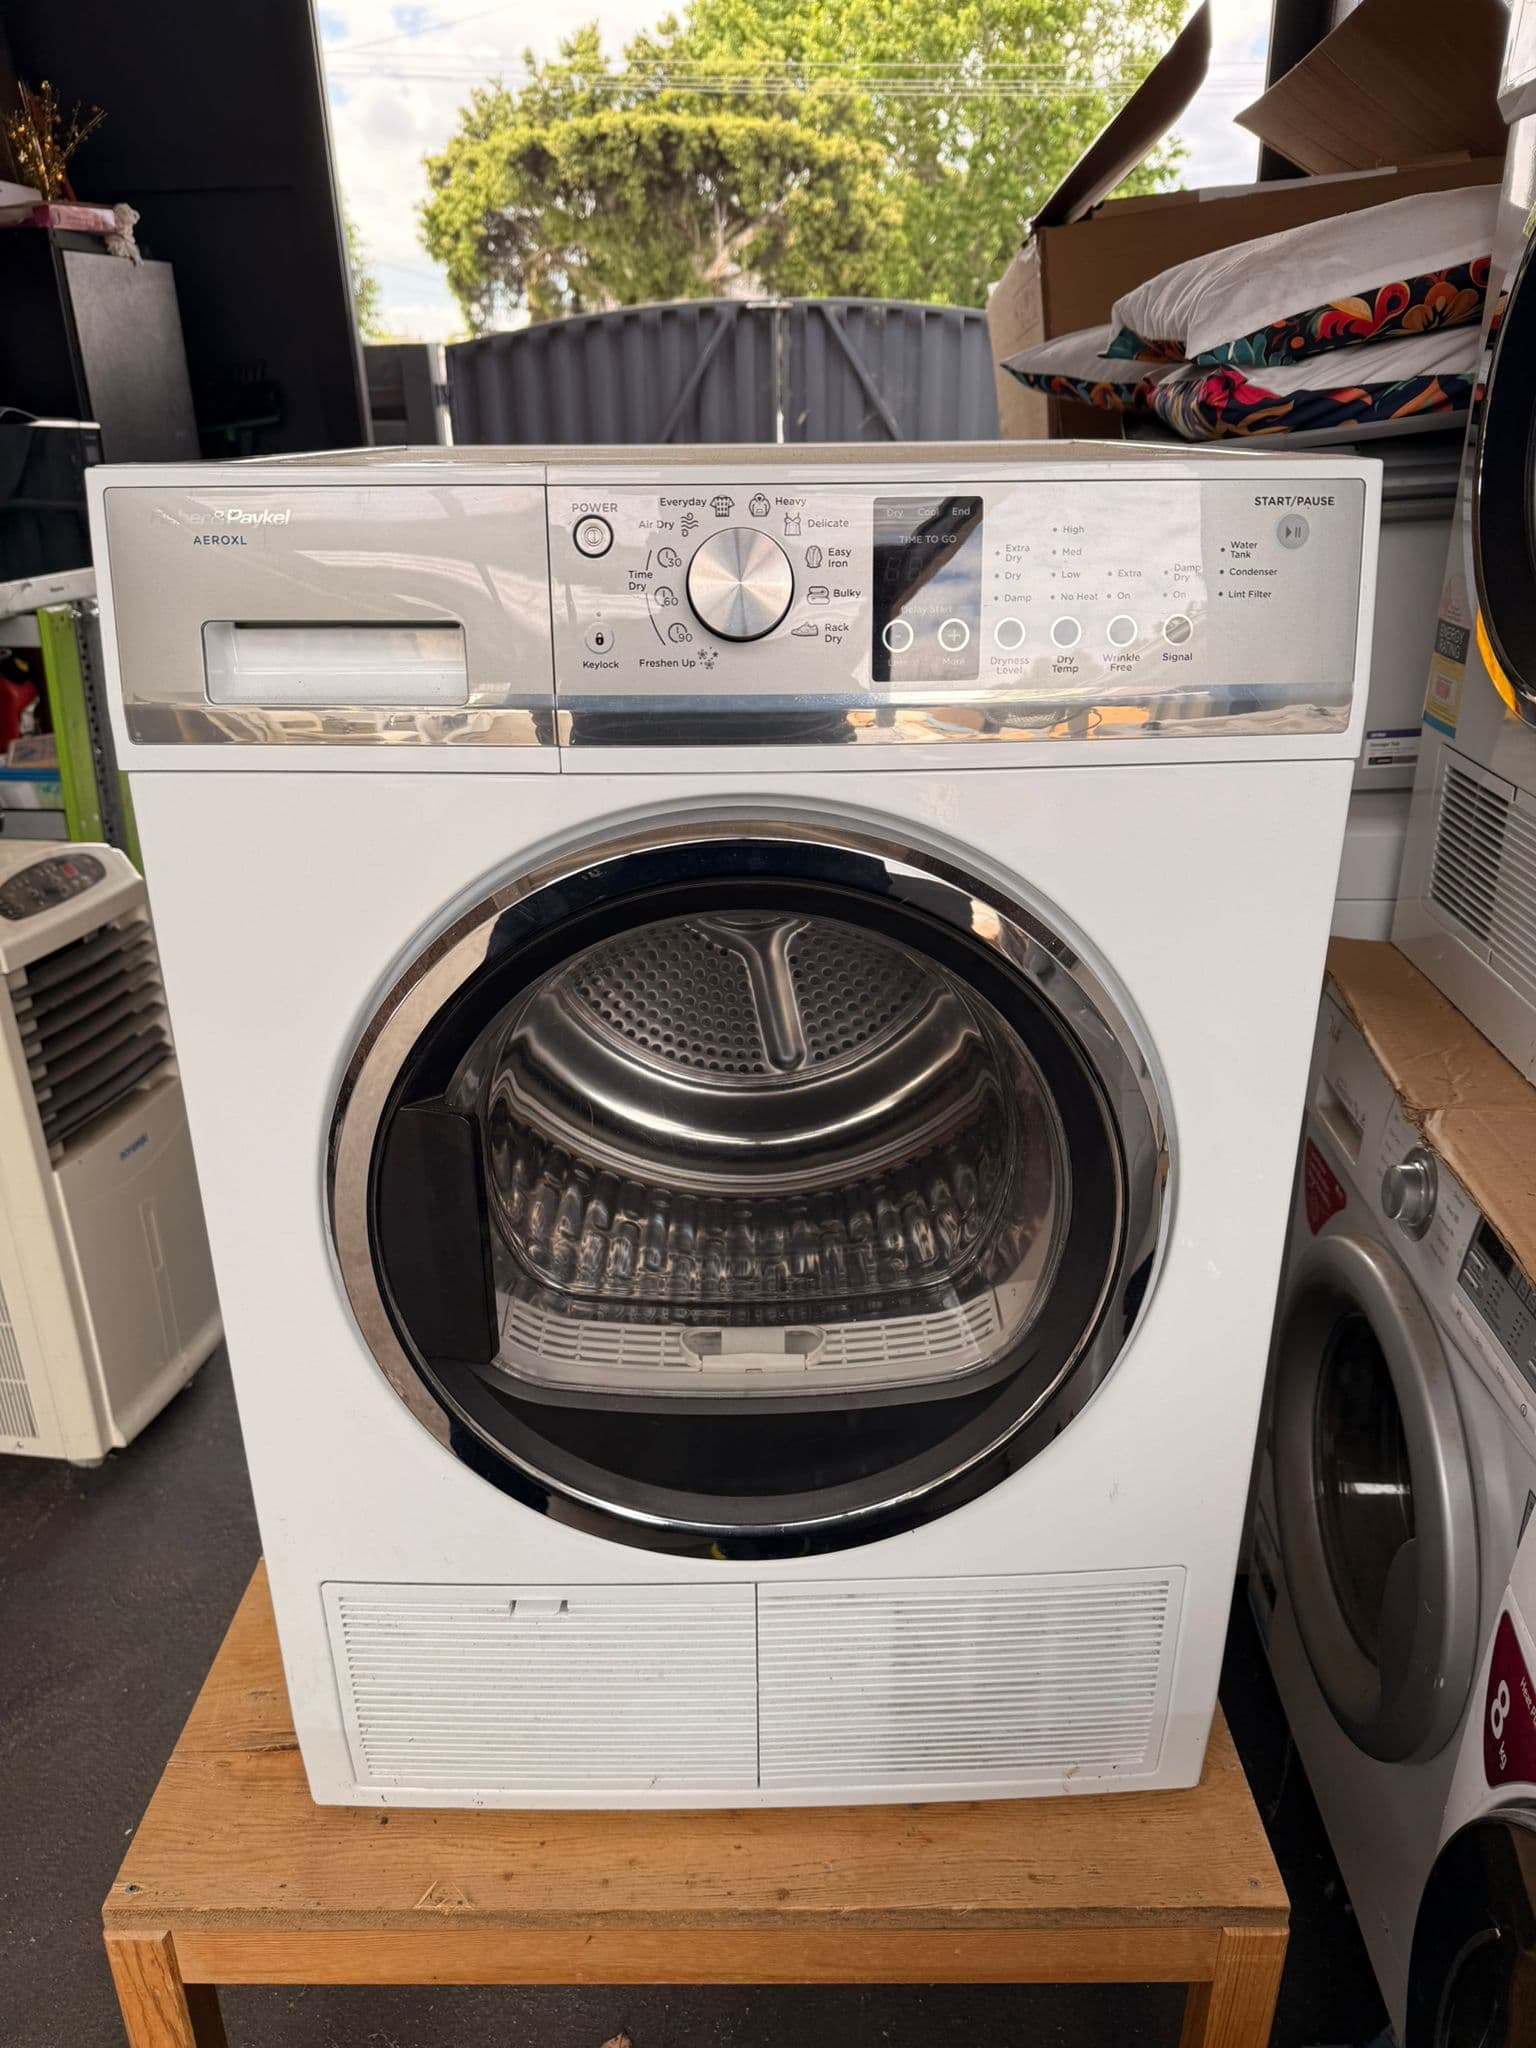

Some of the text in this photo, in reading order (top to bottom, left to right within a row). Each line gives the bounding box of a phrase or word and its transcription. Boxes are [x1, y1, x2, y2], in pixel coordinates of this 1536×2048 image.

[660, 498, 707, 507] Everyday
[776, 497, 806, 507] Heavy
[1255, 496, 1335, 507] START/PAUSE
[572, 503, 618, 513] POWER
[953, 507, 970, 516] End
[887, 508, 903, 518] Dry
[639, 520, 674, 531] Air Dry
[808, 519, 849, 528] Delicate
[1063, 526, 1084, 534] High
[193, 535, 248, 545] AEROXL
[900, 536, 923, 544] TIME
[941, 535, 957, 543] GO
[1231, 541, 1257, 549] Water
[828, 548, 851, 559] Easy
[1063, 548, 1081, 556] Med
[667, 558, 682, 568] 30
[1006, 554, 1022, 563] Dry
[828, 559, 848, 568] Iron
[1174, 564, 1201, 573] Damp
[1229, 568, 1278, 576] Condenser
[628, 570, 653, 579] Time
[1005, 572, 1021, 581] Dry
[1174, 574, 1190, 582] Dry
[629, 582, 647, 592] Dry
[833, 589, 861, 599] Bulky
[1004, 594, 1032, 603] Damp
[1061, 593, 1098, 601] No Heat
[1173, 591, 1186, 599] On
[1228, 590, 1271, 598] Lint Filter
[664, 597, 678, 607] 60
[825, 623, 849, 632] Rack
[679, 633, 692, 643] 90
[825, 634, 843, 644] Dry
[990, 657, 1030, 666] Dryness
[1057, 655, 1074, 665] Dry
[1102, 653, 1140, 662] Wrinkle
[1163, 652, 1192, 662] Signal
[583, 660, 619, 670] Keylock
[640, 659, 695, 669] Freshen Up
[1110, 664, 1132, 672] Free
[997, 666, 1023, 675] Level
[1052, 665, 1079, 673] Temp
[1491, 1680, 1511, 1771] 8 kg
